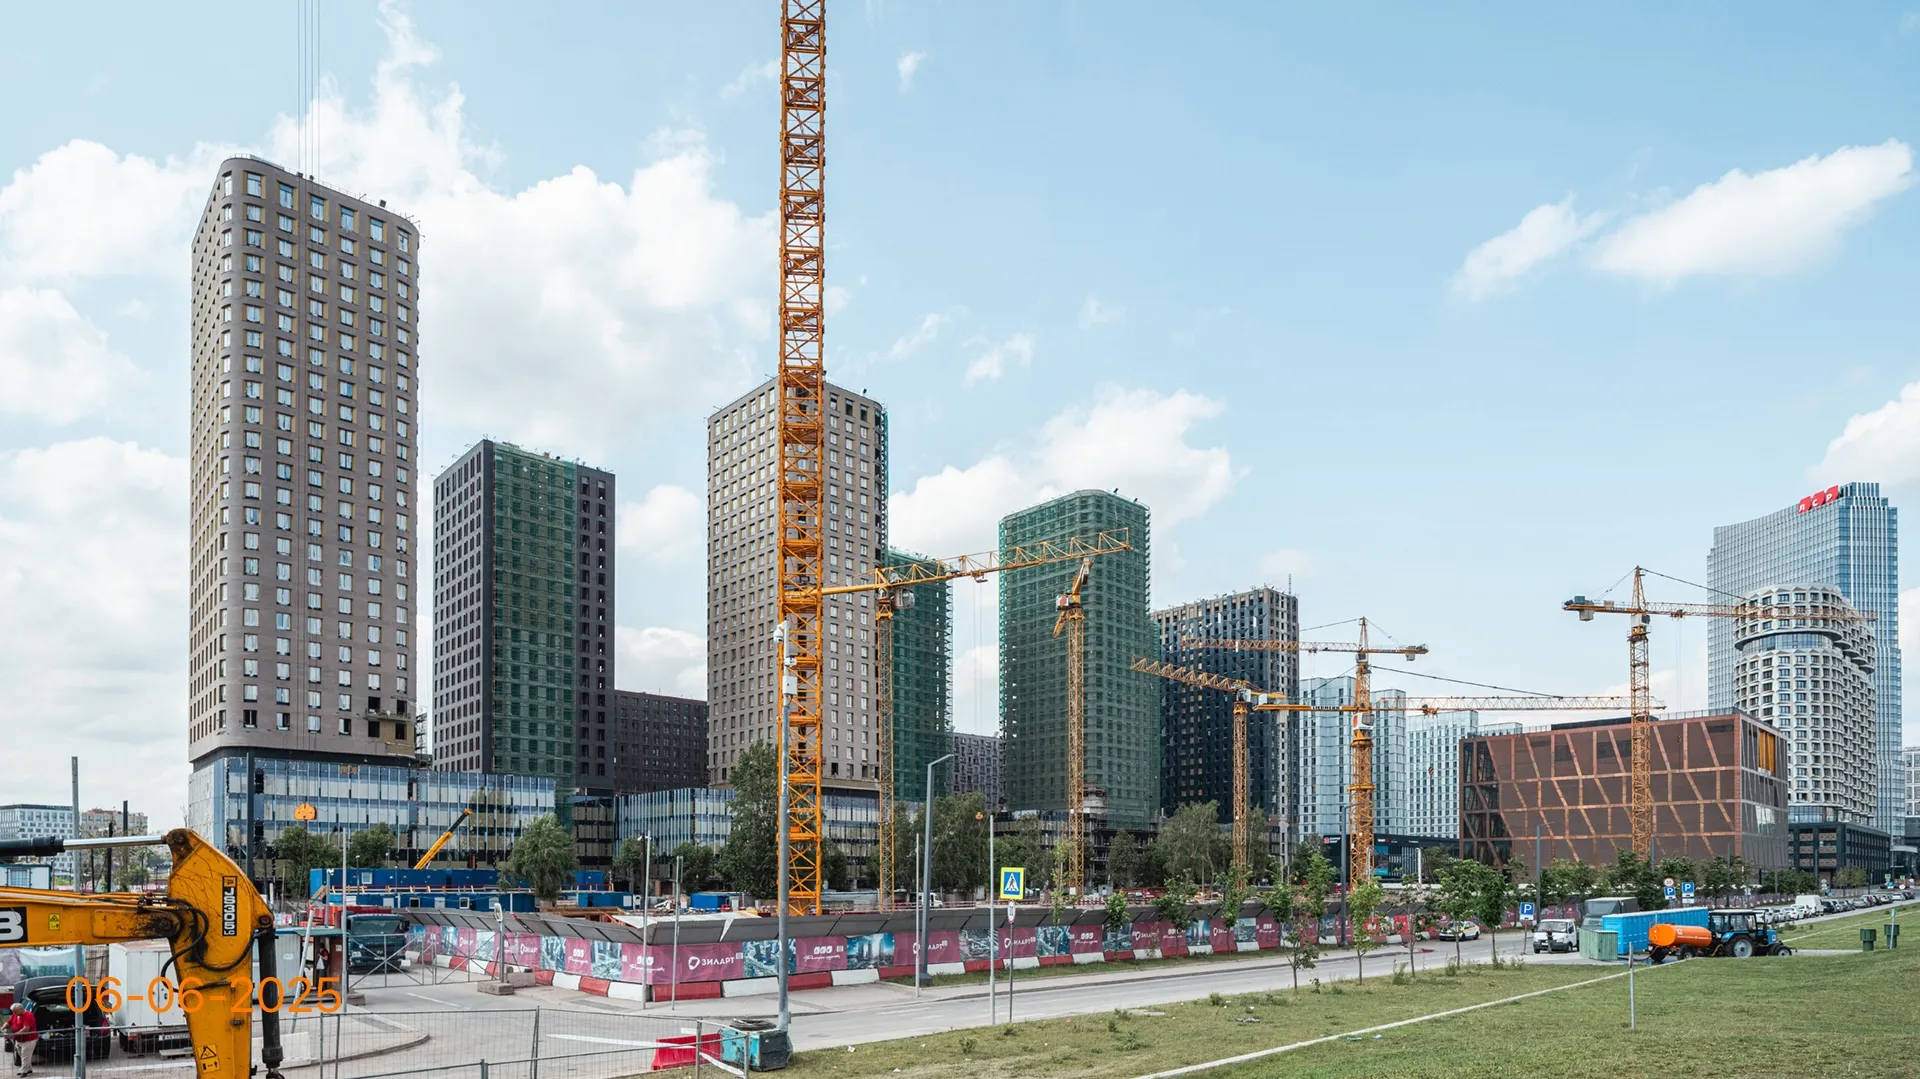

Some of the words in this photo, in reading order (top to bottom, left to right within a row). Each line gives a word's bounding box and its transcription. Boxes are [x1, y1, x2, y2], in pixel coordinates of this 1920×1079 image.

[1799, 494, 1832, 512] ЛСР
[1685, 884, 1692, 892] P
[1524, 904, 1532, 914] P
[701, 957, 735, 966] ЗИЛАРТ
